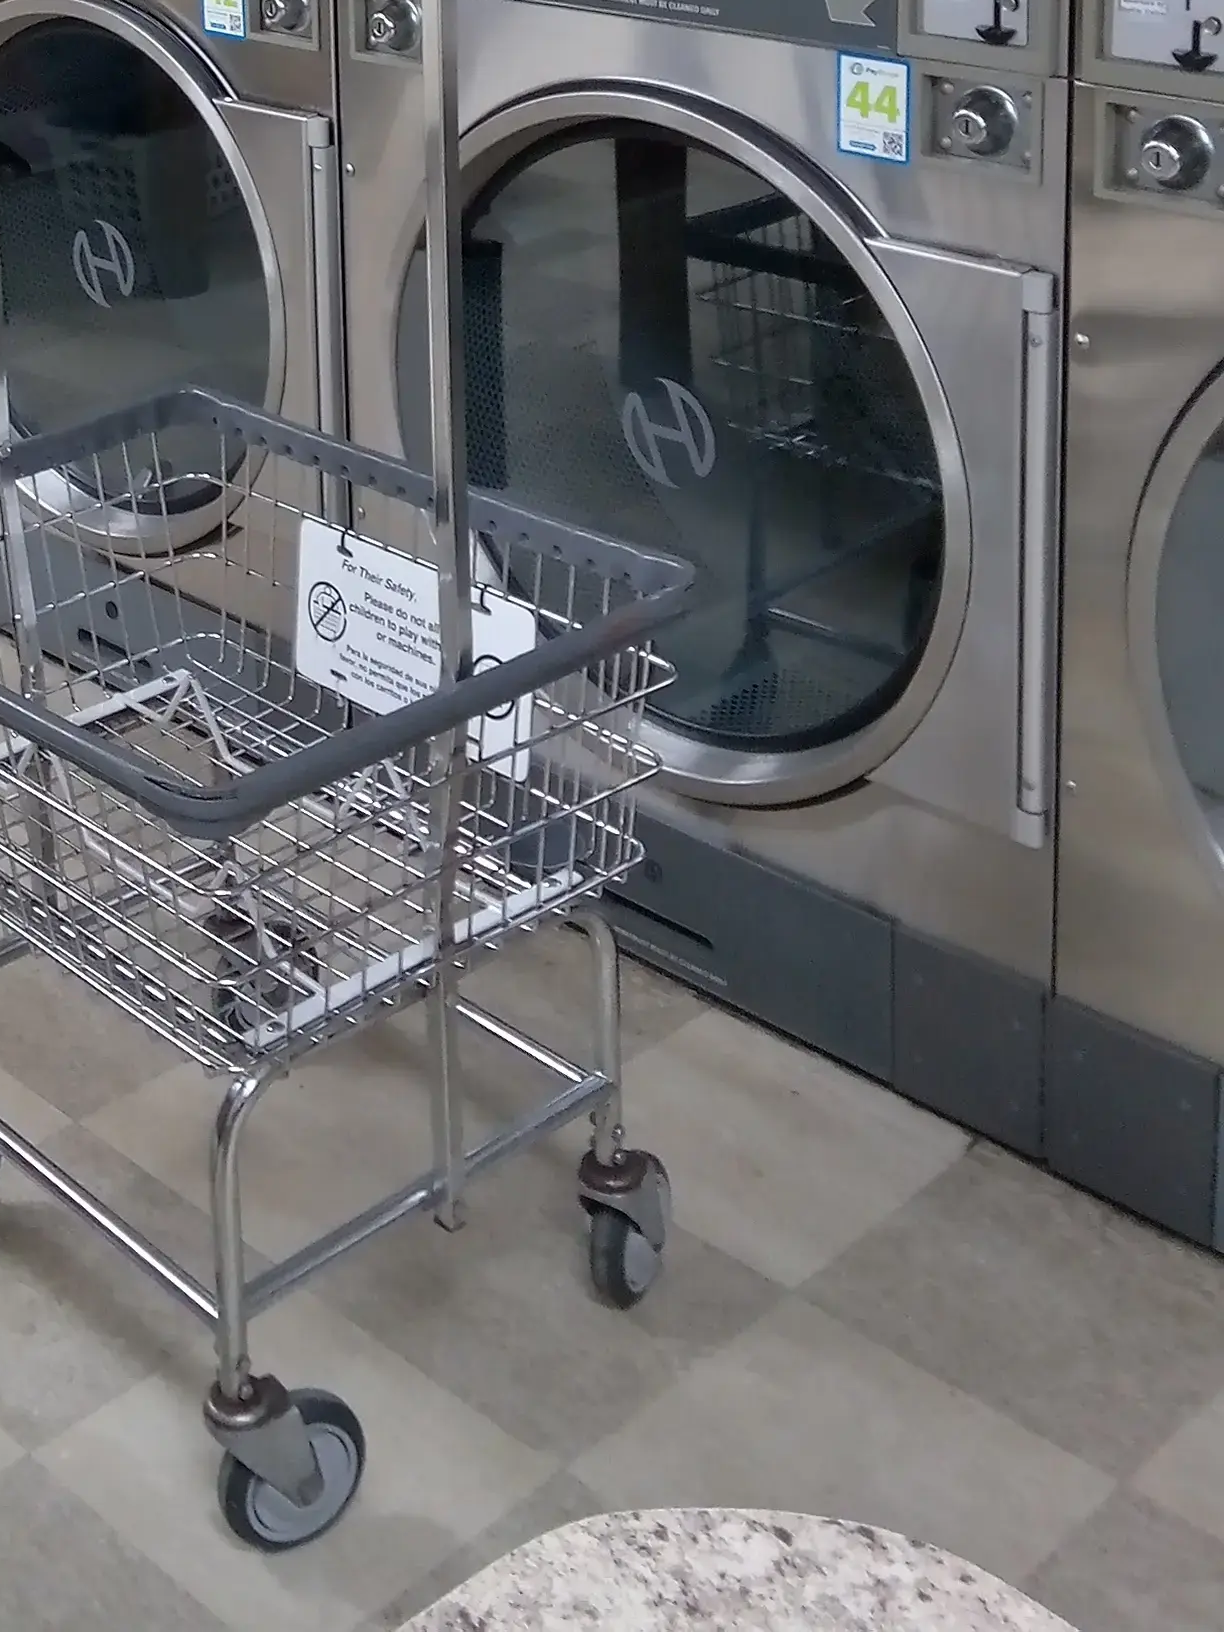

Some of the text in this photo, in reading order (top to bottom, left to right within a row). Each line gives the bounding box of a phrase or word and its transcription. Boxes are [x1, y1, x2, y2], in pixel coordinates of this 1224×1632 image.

[846, 81, 900, 123] 44
[342, 559, 357, 574] For
[359, 566, 383, 585] Their
[349, 604, 385, 626] children
[388, 619, 397, 631] to
[399, 625, 418, 644] play
[364, 592, 394, 614] Please
[396, 608, 408, 620] do
[410, 615, 426, 628] not
[376, 632, 387, 642] or
